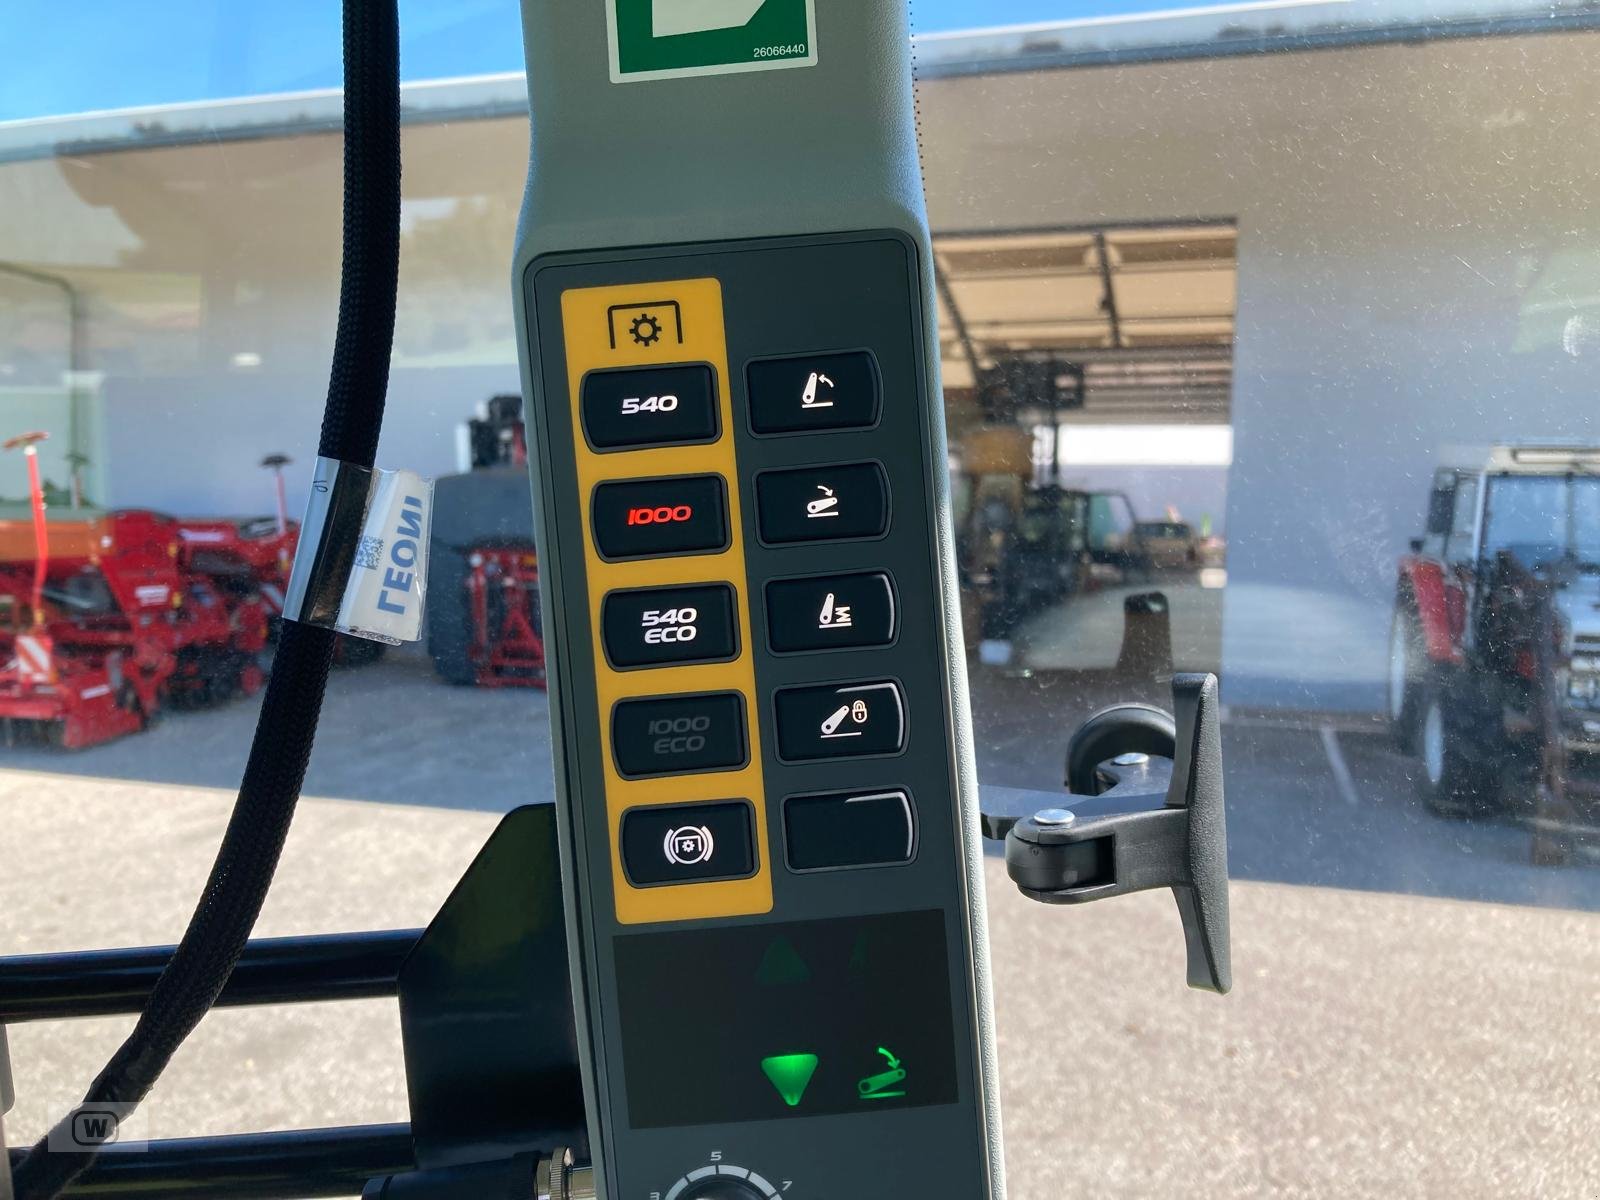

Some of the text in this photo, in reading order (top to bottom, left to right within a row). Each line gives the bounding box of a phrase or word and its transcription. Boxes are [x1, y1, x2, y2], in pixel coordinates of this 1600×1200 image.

[753, 43, 805, 58] 26066440
[621, 395, 678, 415] 540
[627, 506, 692, 526] 1000
[641, 607, 697, 627] 540
[644, 625, 697, 644] ECO
[648, 716, 711, 736] 1000
[654, 735, 706, 754] ECO
[710, 1151, 722, 1161] 5
[781, 1180, 793, 1191] 7
[649, 1191, 661, 1200] 3
